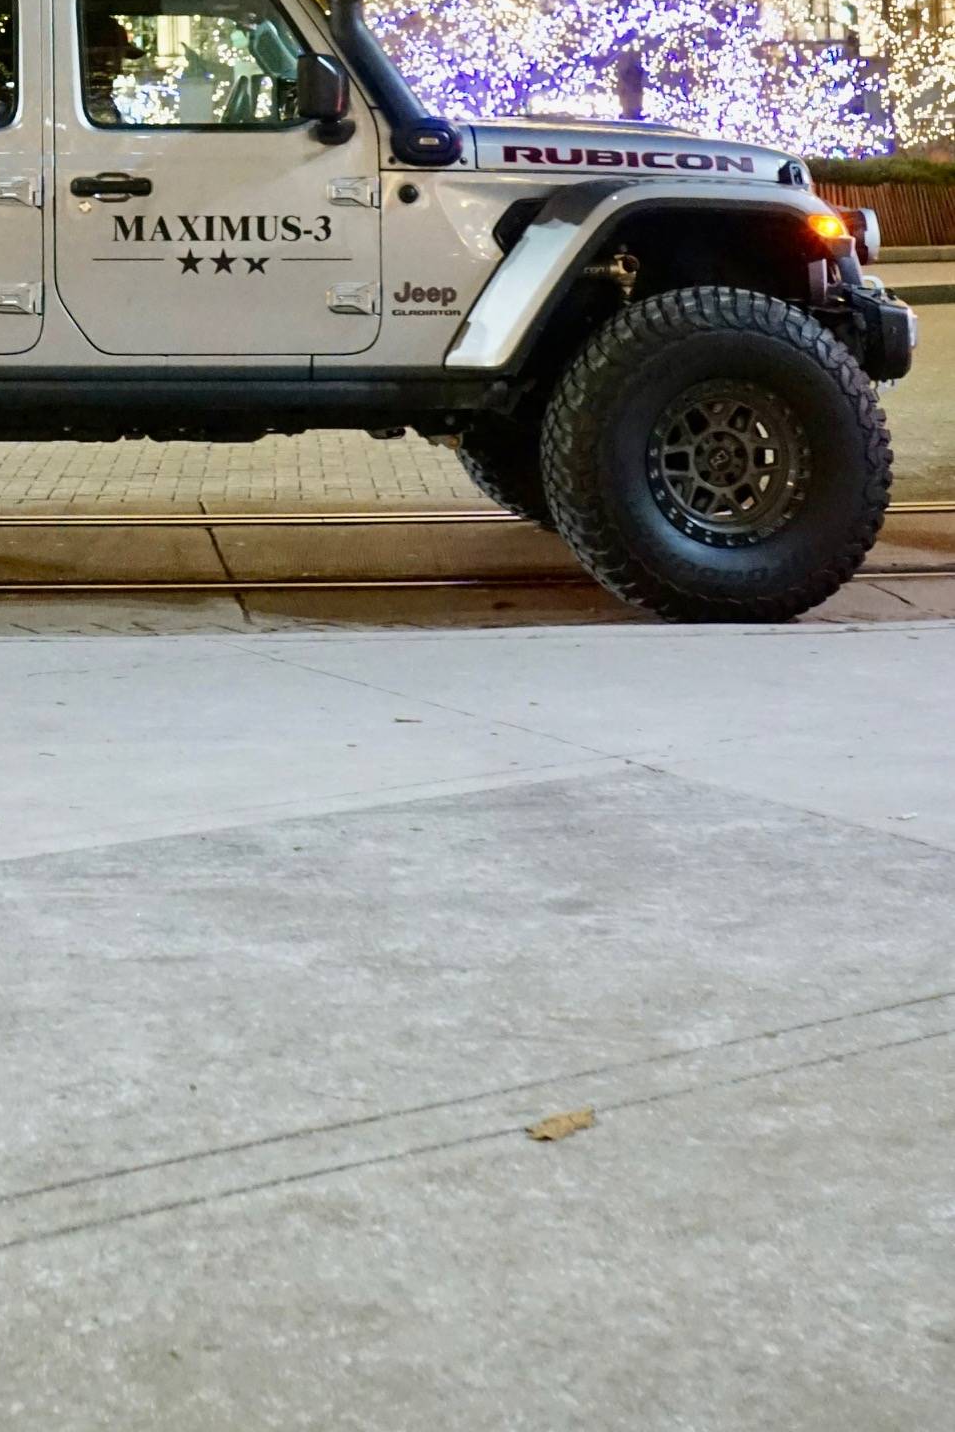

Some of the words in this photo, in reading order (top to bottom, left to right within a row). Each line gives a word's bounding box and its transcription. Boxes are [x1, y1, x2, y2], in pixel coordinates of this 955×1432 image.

[502, 145, 755, 173] RUBICON
[111, 214, 333, 242] MAXIMUS-3
[393, 281, 457, 307] Jeep
[391, 309, 462, 317] GLADIATOR
